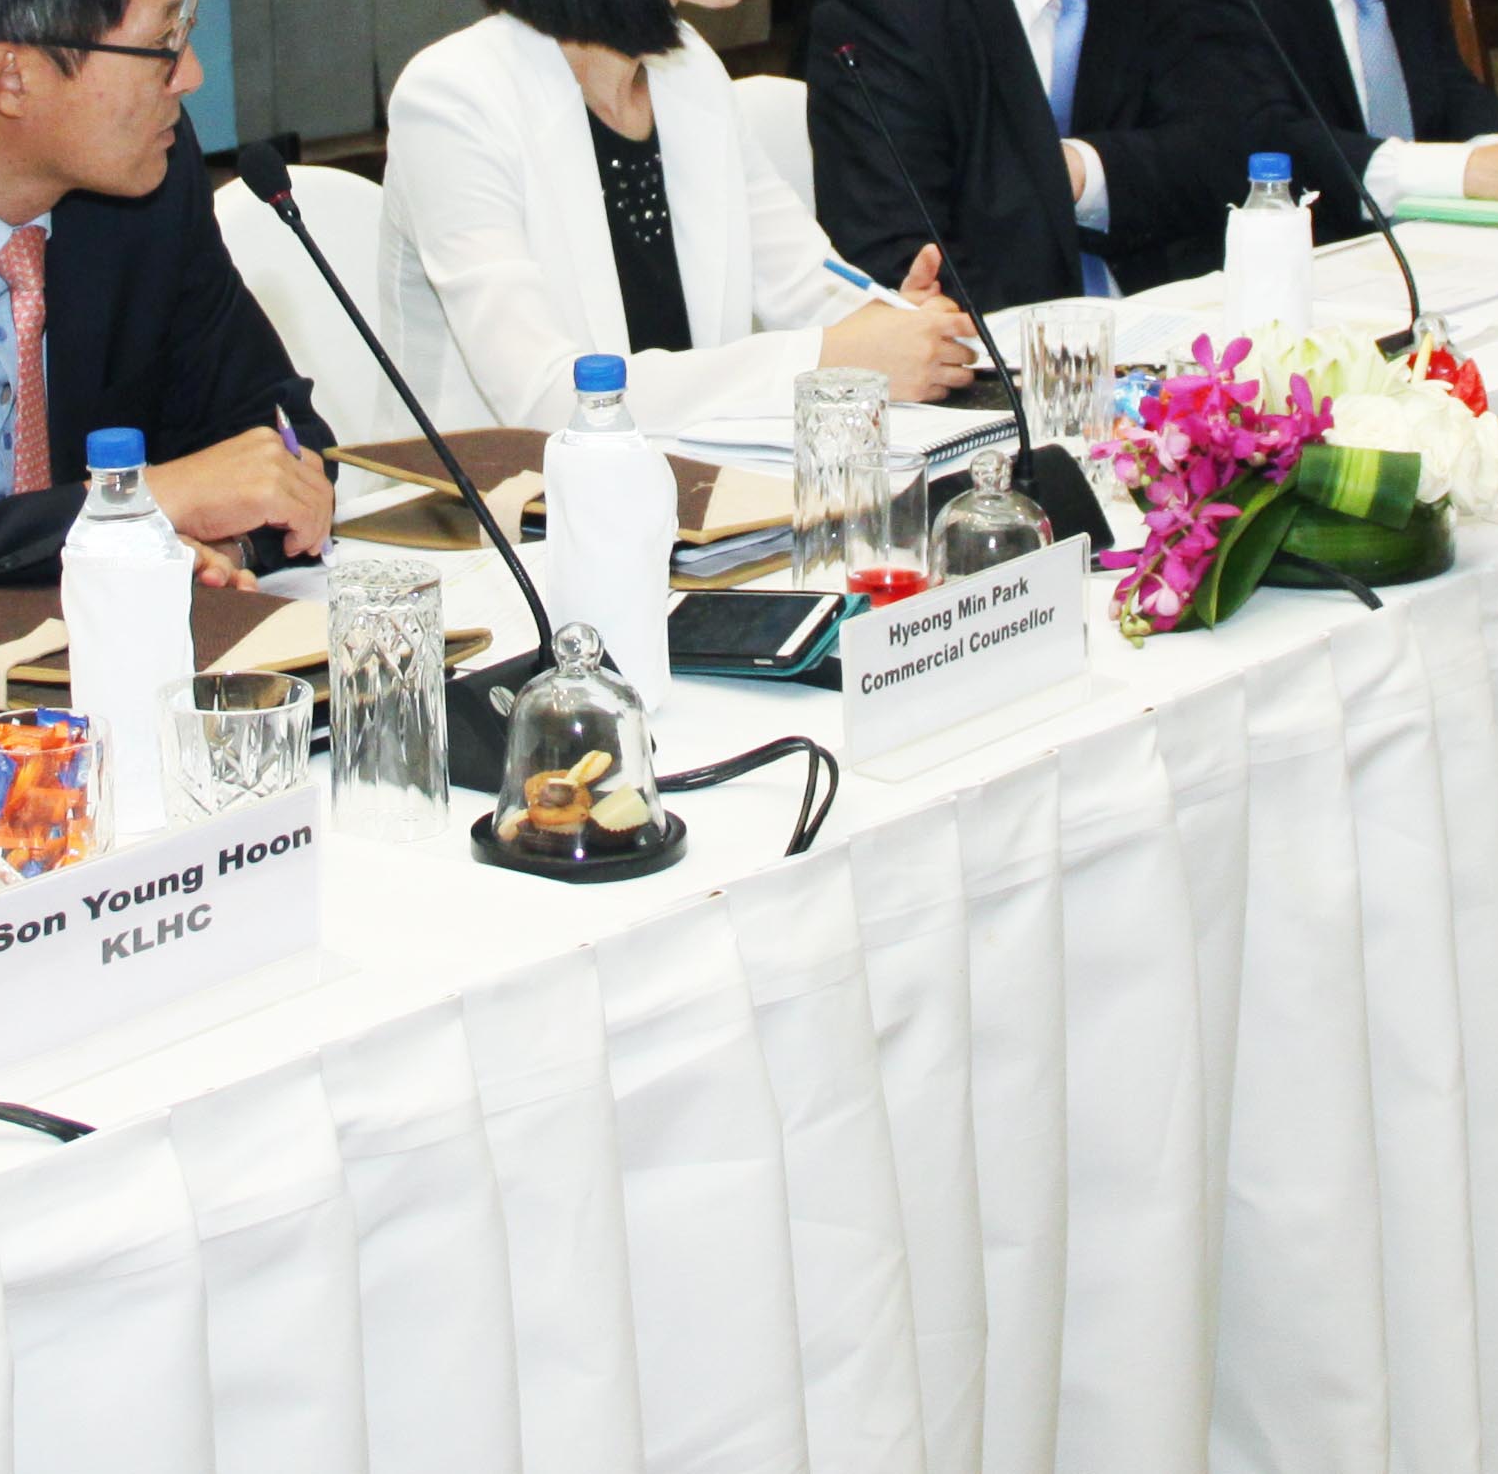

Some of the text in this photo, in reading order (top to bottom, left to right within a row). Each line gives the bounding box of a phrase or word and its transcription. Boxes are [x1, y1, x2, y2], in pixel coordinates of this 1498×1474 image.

[860, 605, 1056, 695] Commercial Counsellor
[889, 576, 1030, 648] Hyeong Min Park
[82, 863, 205, 922] Young
[218, 824, 313, 876] Hoon
[101, 903, 214, 965] KLHC
